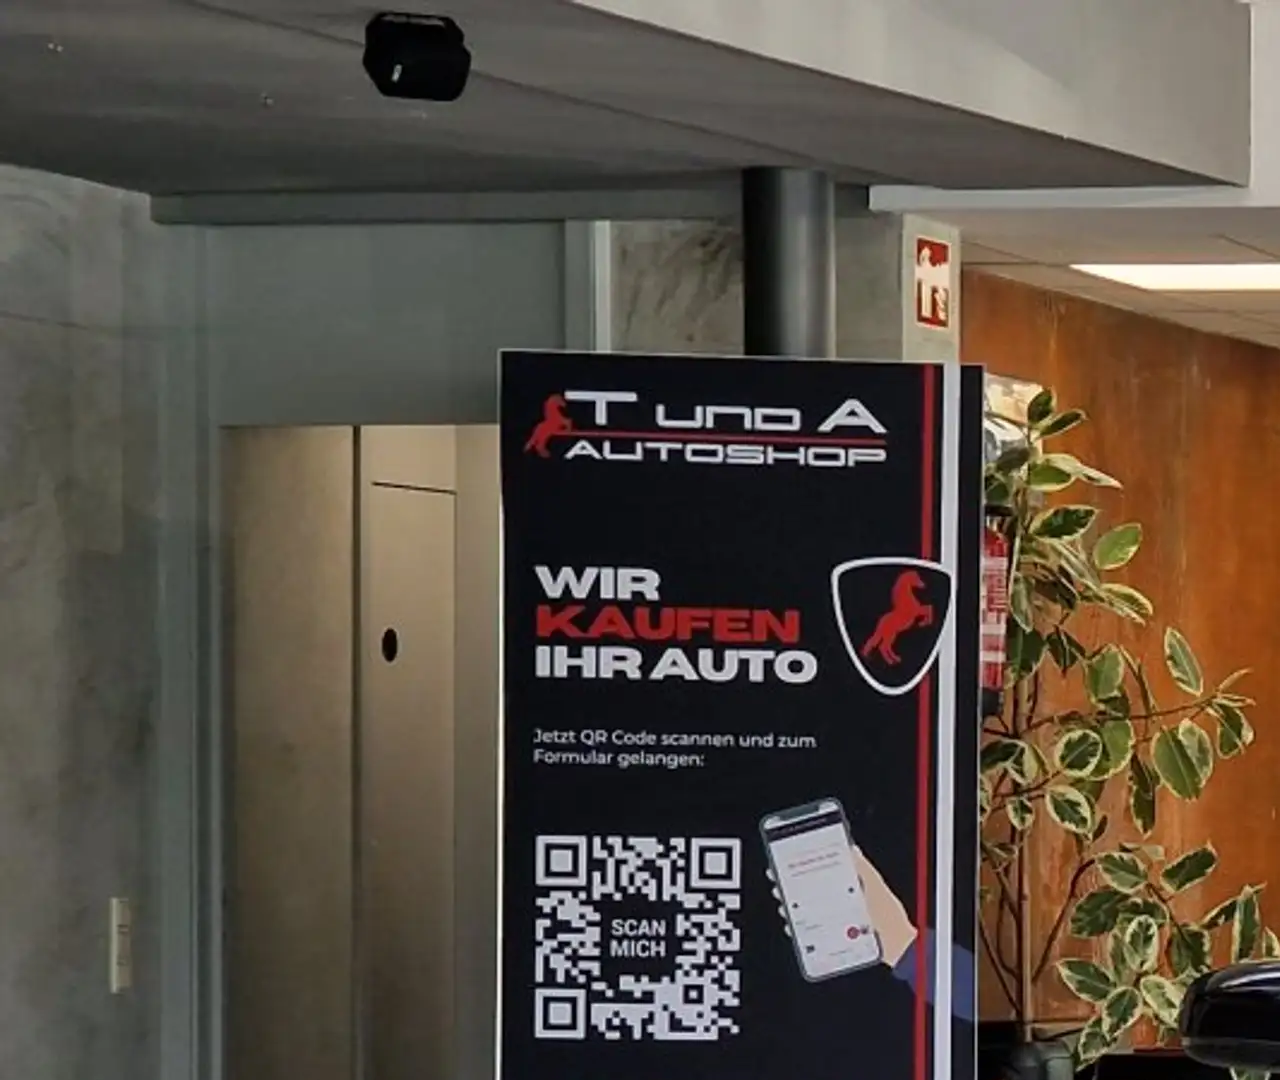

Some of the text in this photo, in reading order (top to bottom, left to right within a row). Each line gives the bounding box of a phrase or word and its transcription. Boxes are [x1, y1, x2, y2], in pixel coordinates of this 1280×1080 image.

[564, 390, 639, 426] T
[817, 398, 888, 434] A
[564, 440, 888, 467] AUTOSHOP
[534, 566, 661, 601] WIR
[535, 606, 801, 643] KAUFEN
[535, 645, 819, 684] IHR AUTO
[533, 729, 817, 749] Jetzt QR Code scannen und zum
[533, 749, 704, 769] Formular gelangen:
[611, 918, 666, 937] SCAN
[610, 938, 666, 958] MICH
